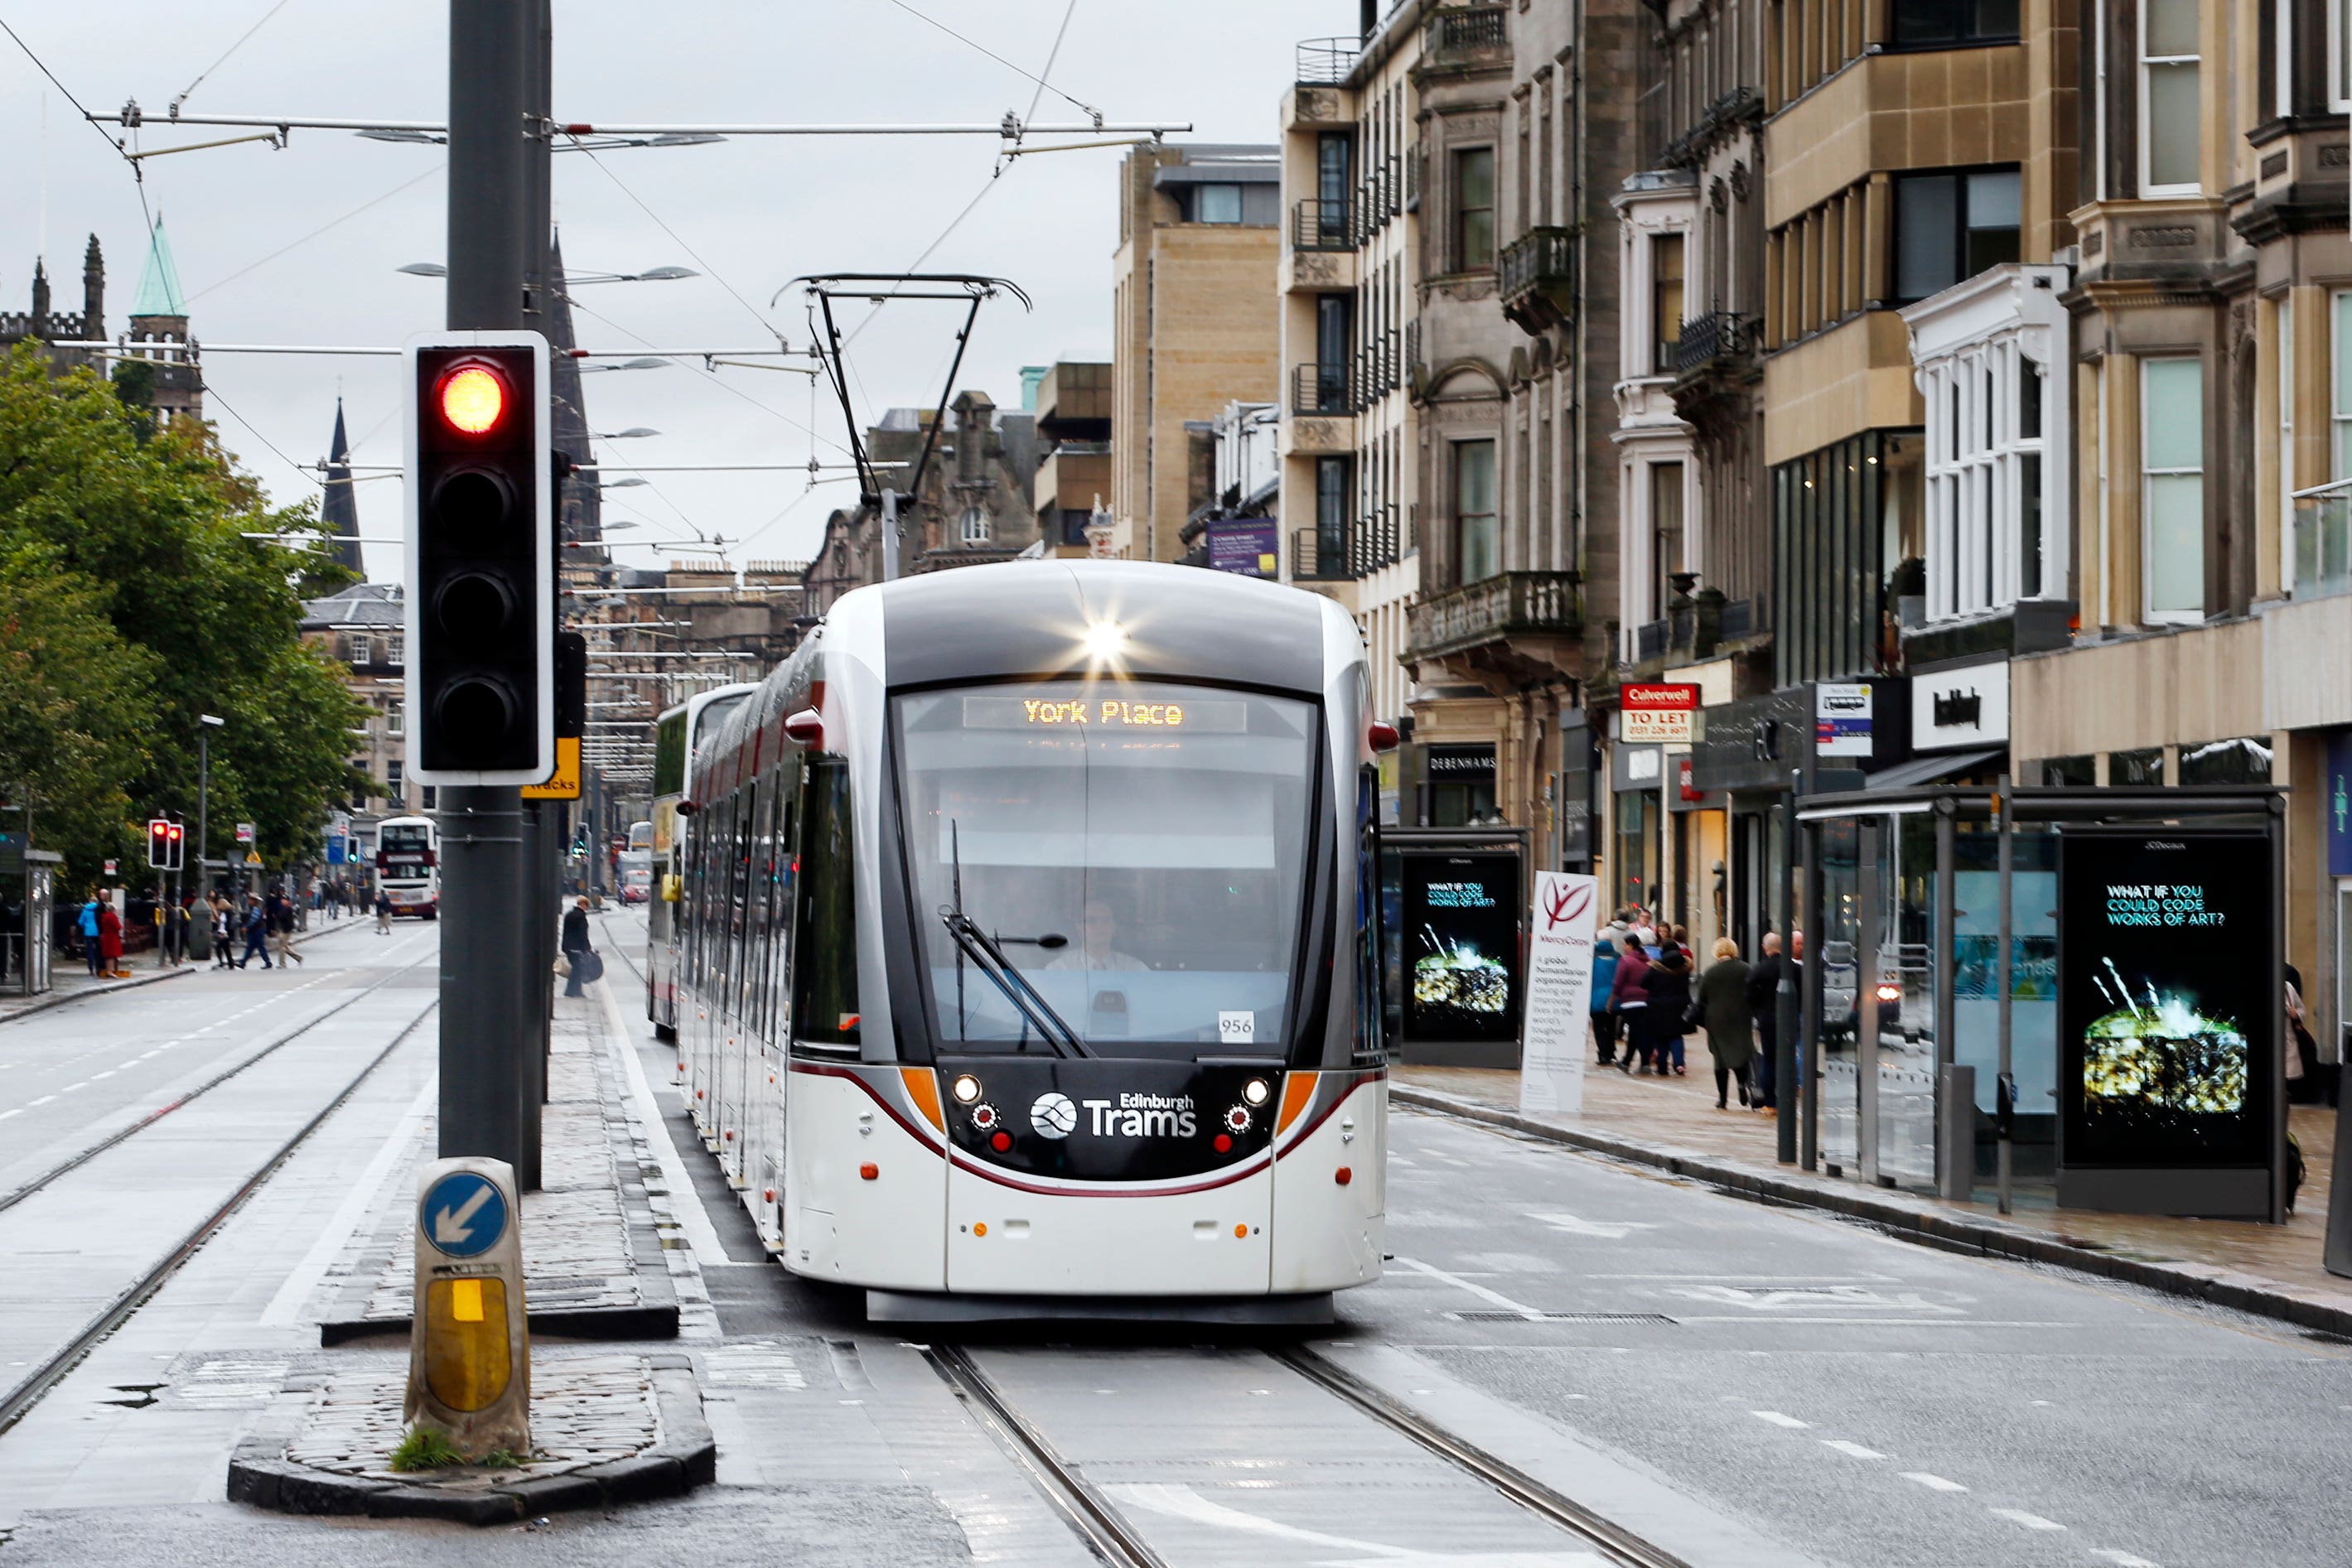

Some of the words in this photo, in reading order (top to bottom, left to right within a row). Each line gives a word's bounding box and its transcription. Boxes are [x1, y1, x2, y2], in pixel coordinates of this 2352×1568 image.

[1629, 688, 1690, 702] Culverwell
[1023, 700, 1089, 723] York
[1101, 701, 1184, 726] Place
[1630, 712, 1652, 724] TO
[1659, 712, 1688, 724] LET
[1431, 756, 1496, 770] DEBENHAMS
[1427, 882, 1455, 892] WHAT
[1454, 882, 1464, 891] IF
[1464, 882, 1484, 892] YOU
[2107, 885, 2153, 899] WHAT
[2154, 885, 2170, 899] IF
[2171, 885, 2204, 899] YOU
[1427, 890, 1459, 900] COULD
[1458, 890, 1485, 900] CODE
[1427, 898, 1459, 908] WORKS
[2107, 899, 2160, 912] COULD
[2162, 899, 2205, 912] CODE
[2107, 912, 2162, 926] WORKS
[2163, 912, 2186, 926] OF
[2188, 912, 2226, 926] ART?
[1222, 1019, 1252, 1034] 956
[1120, 1093, 1194, 1112] Edinburgh
[1082, 1099, 1197, 1138] Trams
